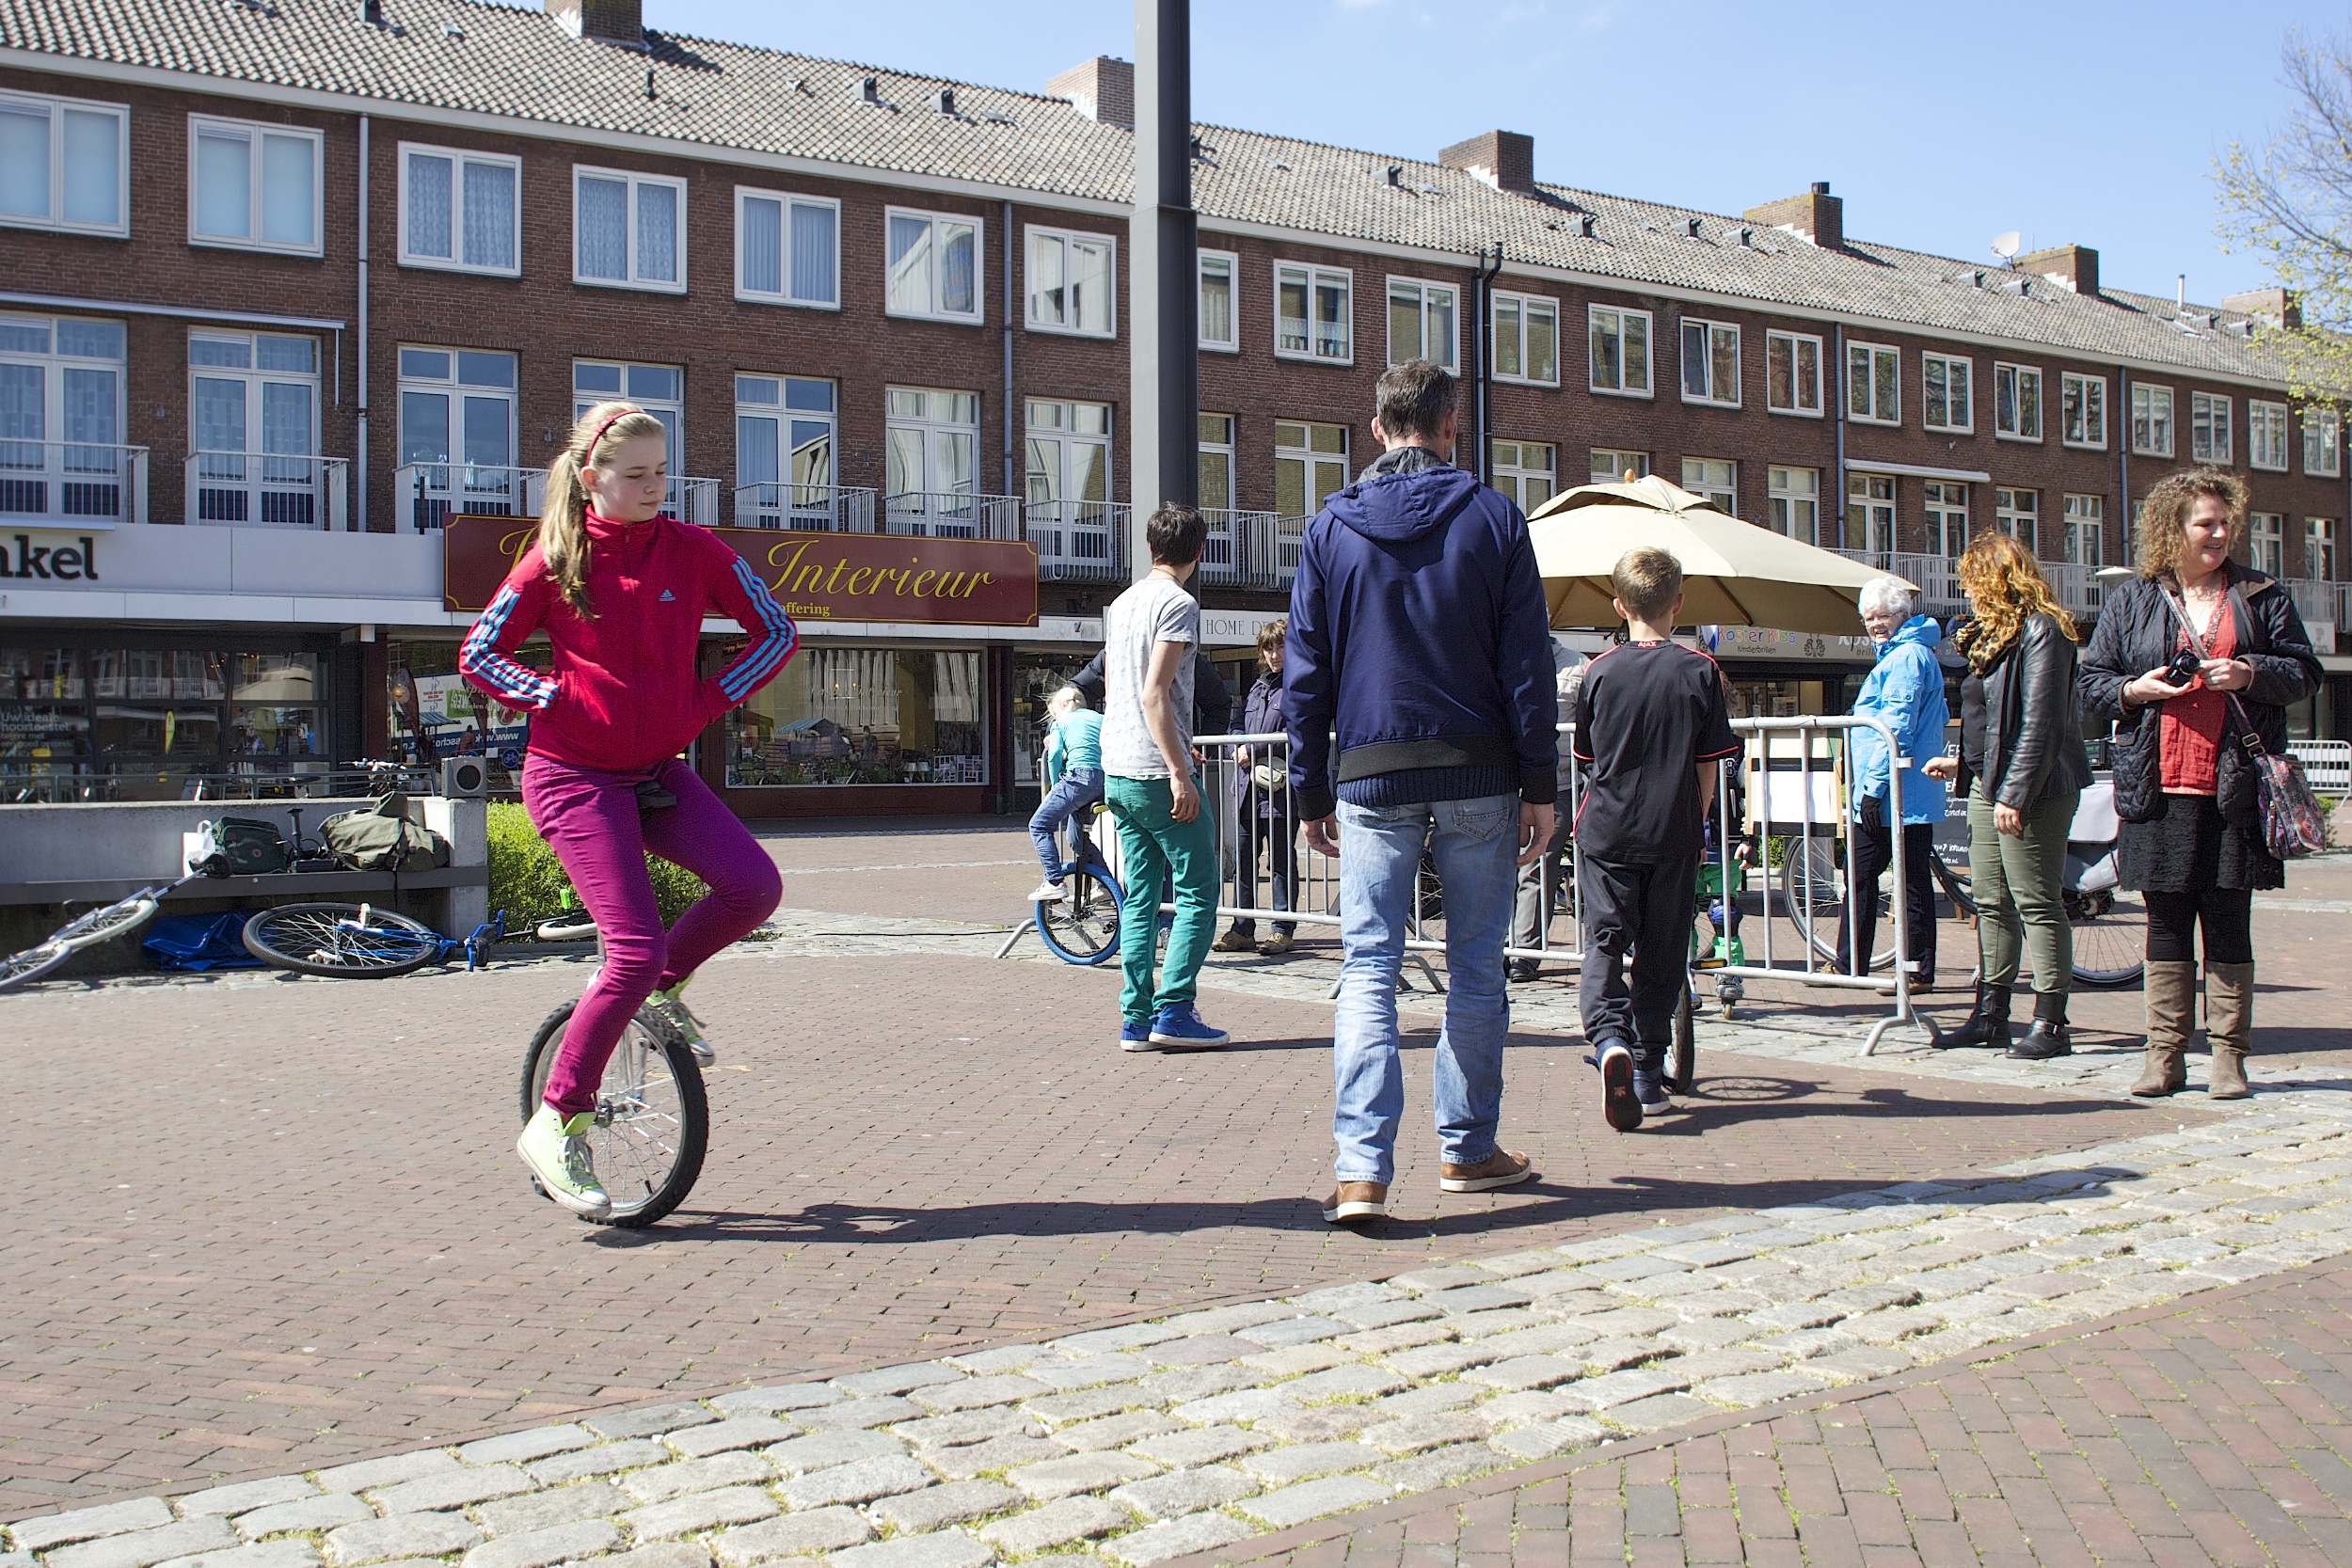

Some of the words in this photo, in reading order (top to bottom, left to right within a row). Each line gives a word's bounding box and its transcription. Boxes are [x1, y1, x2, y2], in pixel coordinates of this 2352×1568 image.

[767, 539, 996, 598] Interieur
[1206, 619, 1244, 635] HOME
[1718, 627, 1763, 642] Koster
[1767, 628, 1796, 644] Kids
[1737, 644, 1776, 655] Kinderbrillen
[1, 721, 70, 732] hoortoestel
